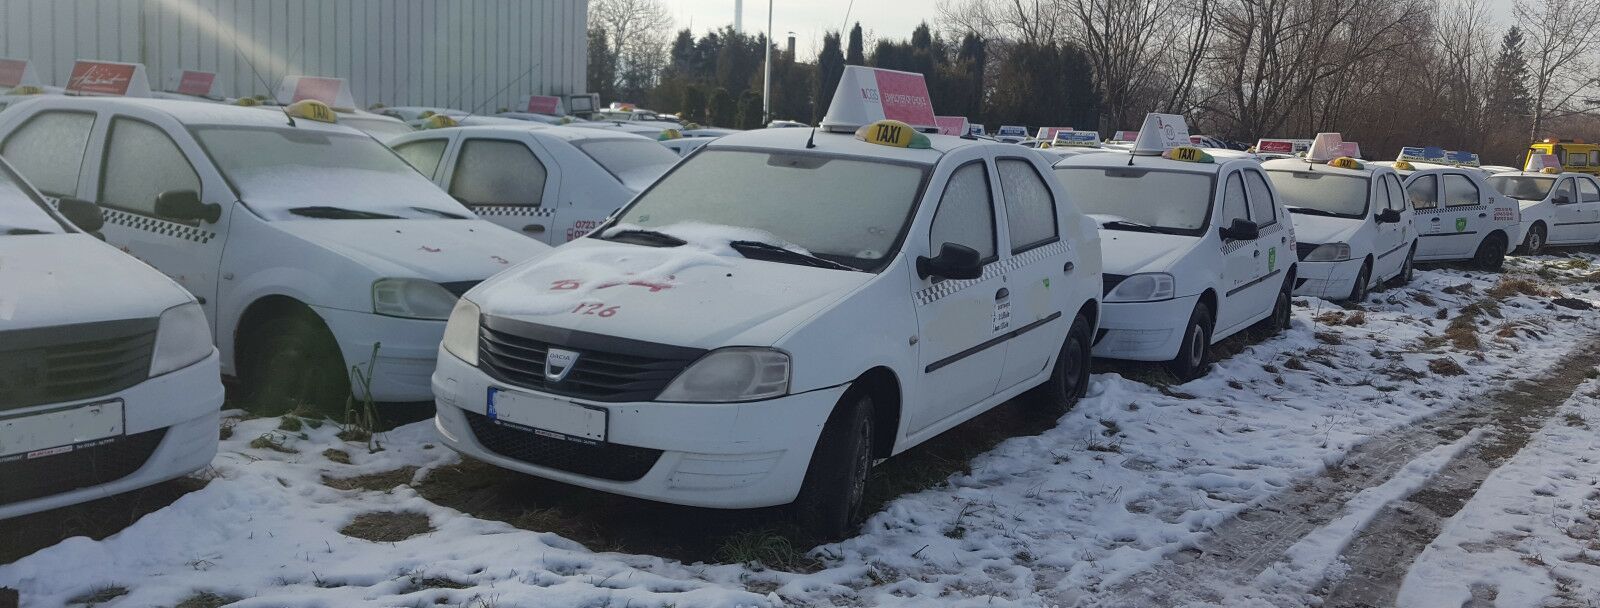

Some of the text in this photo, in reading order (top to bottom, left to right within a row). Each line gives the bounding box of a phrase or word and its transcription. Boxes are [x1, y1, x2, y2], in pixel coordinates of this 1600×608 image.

[310, 103, 330, 121] TAXI
[876, 123, 902, 144] TAXI
[1178, 147, 1196, 160] TAXI
[1339, 159, 1352, 167] TAXI
[575, 220, 596, 229] 0723
[571, 302, 620, 317] 126
[549, 352, 570, 361] DACIA
